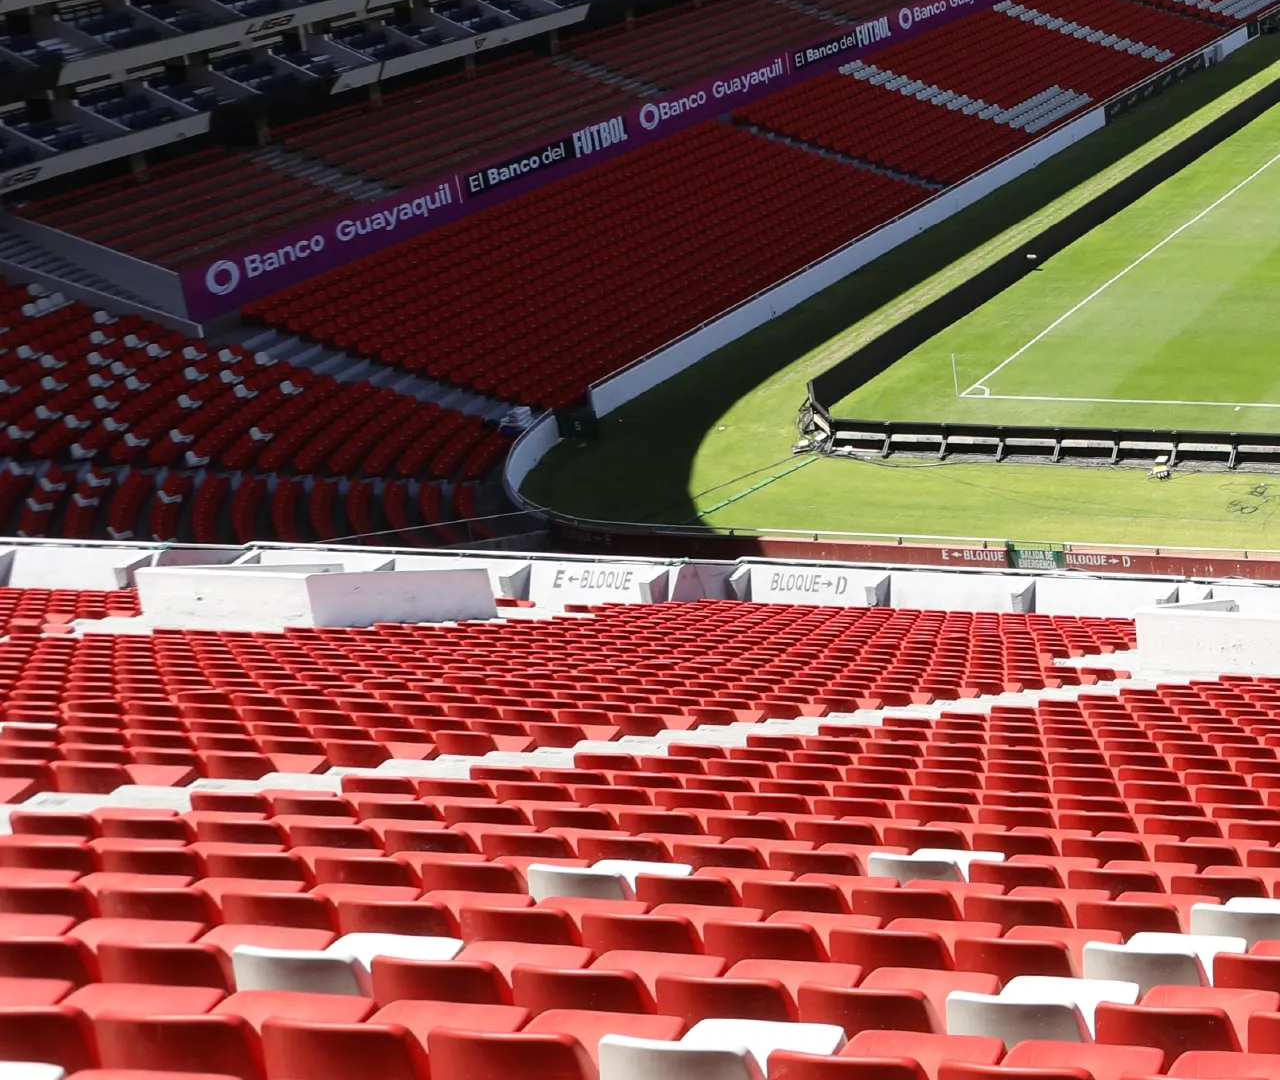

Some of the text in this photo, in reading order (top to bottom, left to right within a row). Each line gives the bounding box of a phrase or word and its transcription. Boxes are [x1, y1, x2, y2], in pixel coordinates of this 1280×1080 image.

[913, 0, 948, 22] Banco
[245, 13, 293, 36] LIGA
[794, 15, 892, 68] El Banco del FÚTBOL
[660, 57, 784, 121] Banco Guayaquil
[468, 115, 629, 193] El Banco del FÚTBOL
[243, 183, 453, 279] Banco Guayaquil
[942, 549, 1005, 562] E BLOQUE
[1018, 558, 1057, 569] EMERGENCIA
[1020, 550, 1054, 560] SALIDA DE
[1065, 554, 1131, 568] BLOQUE D
[552, 569, 633, 591] E BLOQUE
[770, 572, 848, 595] BLOQUE D
